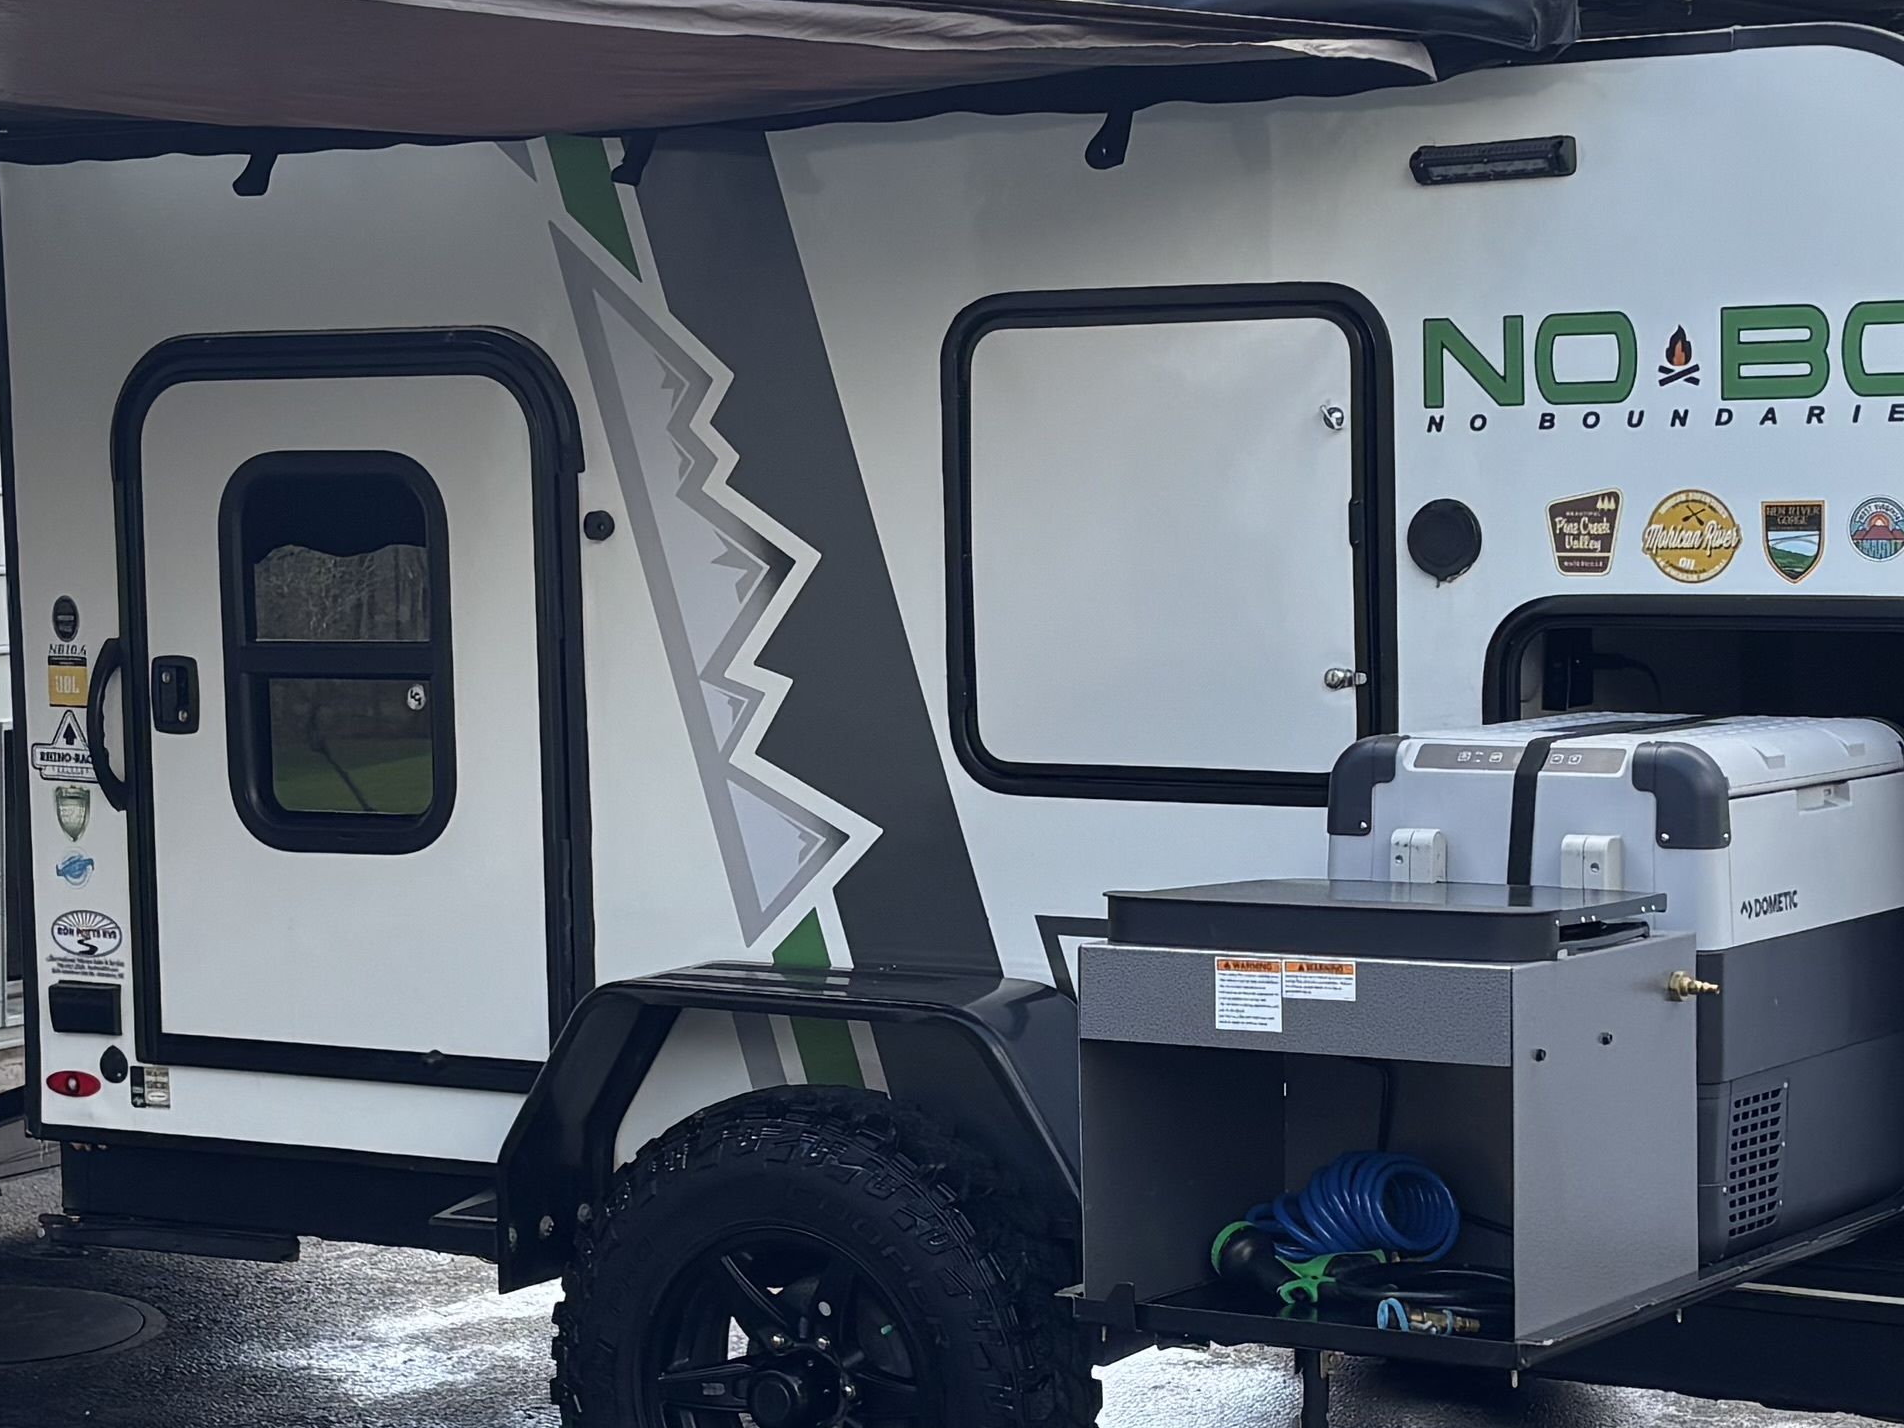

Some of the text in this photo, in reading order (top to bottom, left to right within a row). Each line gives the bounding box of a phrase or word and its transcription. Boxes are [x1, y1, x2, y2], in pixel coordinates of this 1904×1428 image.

[1426, 414, 1488, 433] NO
[1555, 517, 1611, 534] Pine Creek
[1565, 535, 1601, 552] Valley
[1646, 520, 1740, 556] Mohican River
[40, 752, 93, 764] RHINO-RAC
[1754, 890, 1798, 918] DOMETIC
[1233, 962, 1273, 972] WARNING
